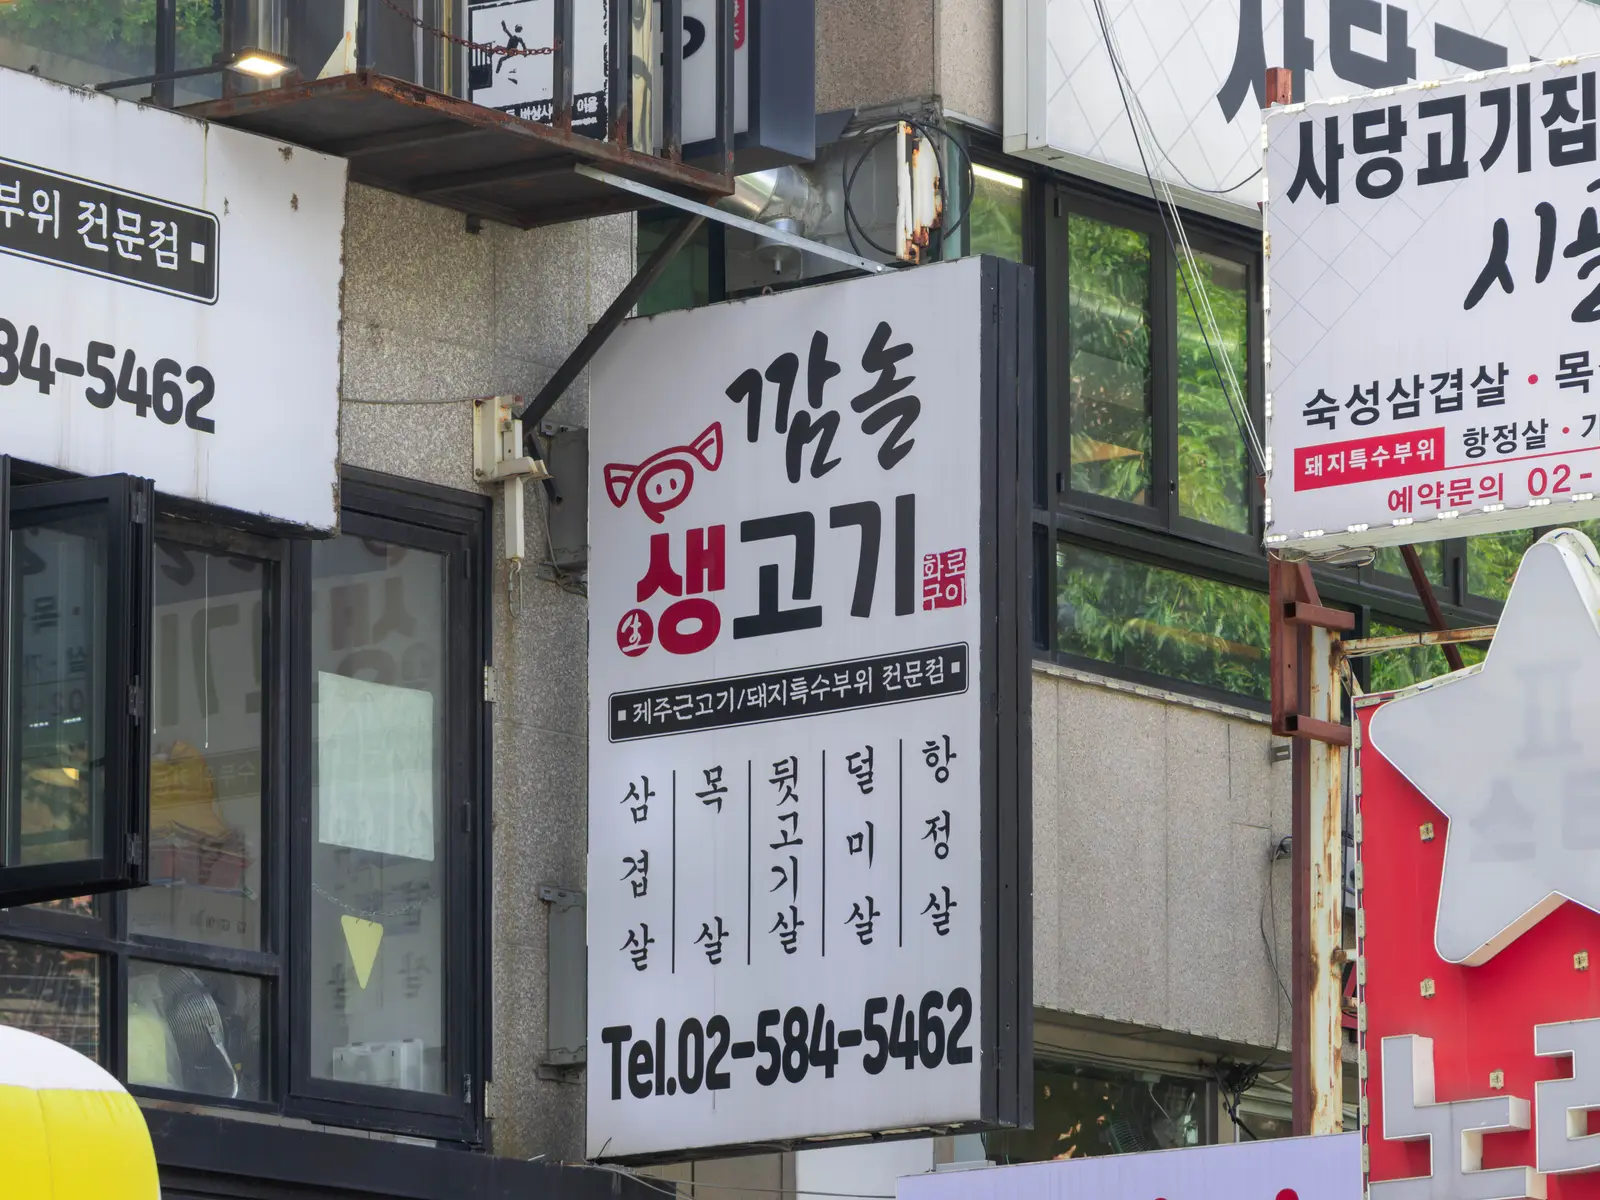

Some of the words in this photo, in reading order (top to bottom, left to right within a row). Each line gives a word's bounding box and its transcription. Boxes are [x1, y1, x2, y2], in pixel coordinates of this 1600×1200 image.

[1286, 71, 1597, 205] 사당고기집
[77, 200, 178, 270] 전문점
[725, 321, 921, 483] 깜놀
[1303, 362, 1509, 430] 숙성삼겹살
[1304, 438, 1436, 477] 돼지특수부위
[1463, 418, 1548, 459] 항정살
[1388, 473, 1504, 513] 예약문의
[637, 493, 915, 655] 생고기
[882, 657, 944, 690] 전문점
[620, 775, 655, 972] 삼겹살
[694, 765, 729, 966] 목살
[768, 755, 804, 955] 뒷고기살
[844, 745, 880, 946] 덜미살
[920, 734, 957, 937] 항정살
[601, 986, 973, 1100] Tel.02-584-5462
